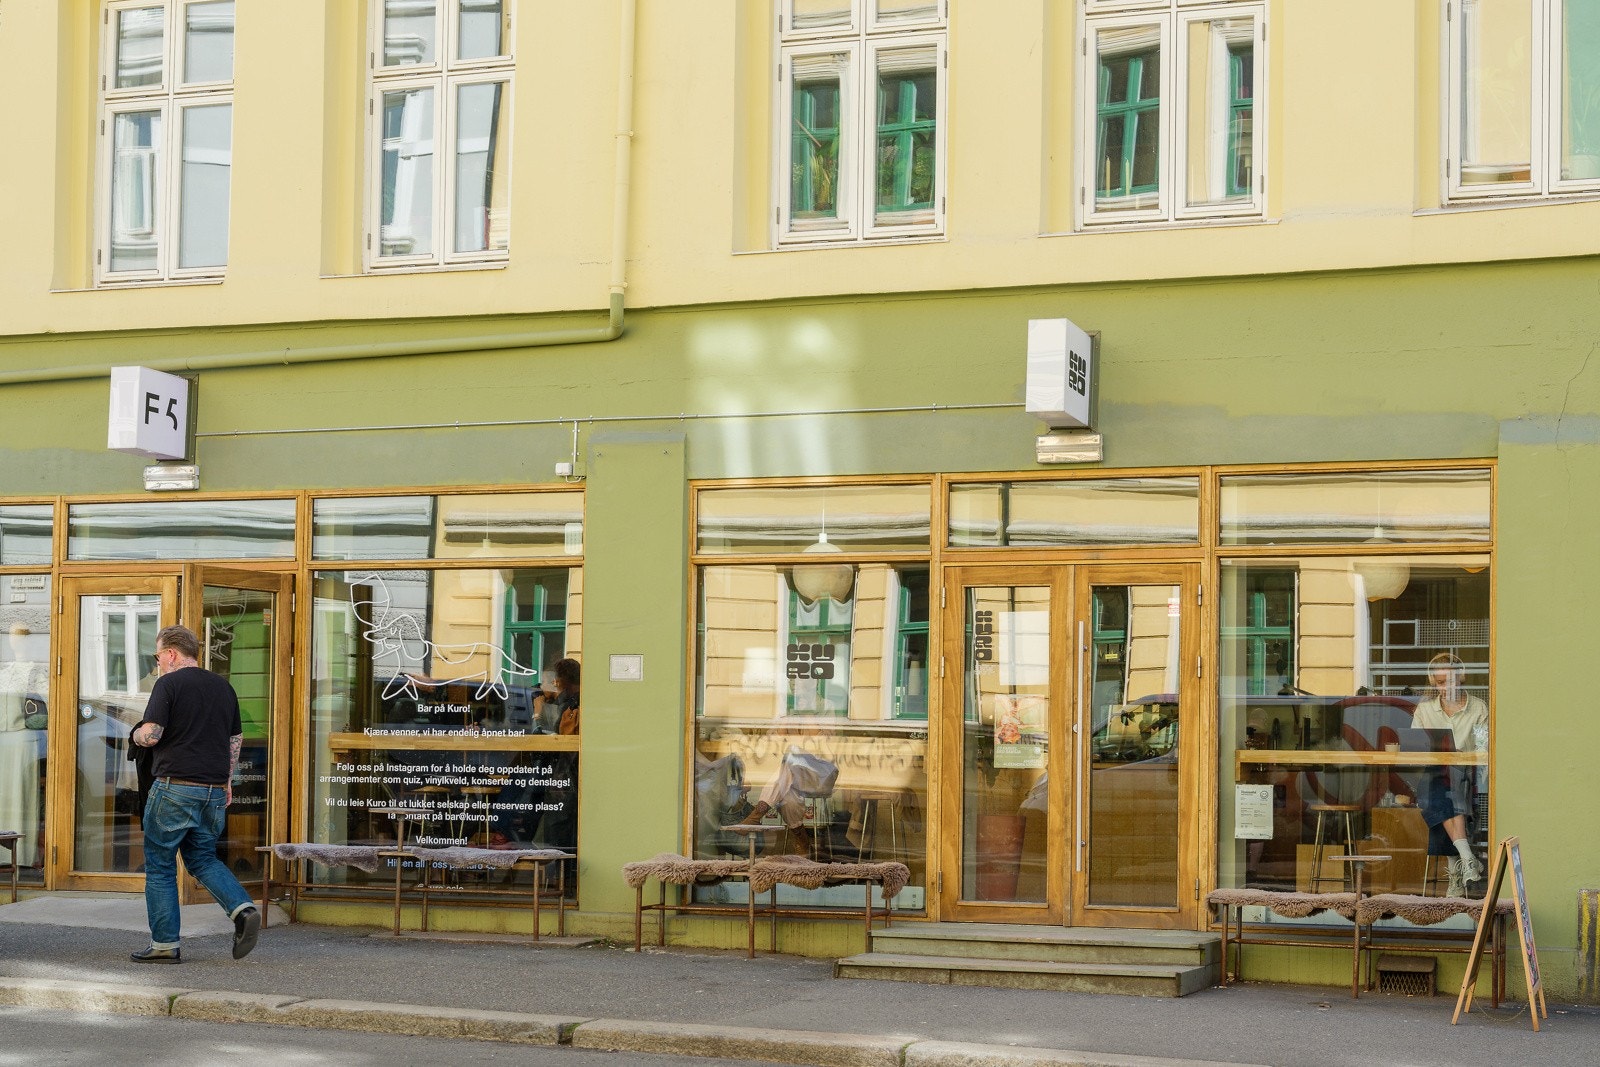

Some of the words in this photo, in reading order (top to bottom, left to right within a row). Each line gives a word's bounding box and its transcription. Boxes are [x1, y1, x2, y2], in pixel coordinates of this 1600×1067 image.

[417, 704, 432, 713] Bar
[434, 704, 445, 714] på
[447, 704, 471, 713] Kuro!
[363, 727, 389, 737] Kjære
[390, 729, 421, 737] venner,
[422, 728, 430, 736] vi
[432, 728, 447, 736] har
[448, 729, 479, 738] endelig
[481, 729, 506, 738] åpnet
[508, 729, 525, 737] bar!
[336, 762, 355, 772] Følg
[373, 763, 384, 773] på
[386, 763, 429, 773] Instagram
[430, 764, 443, 772] for
[444, 764, 451, 773] å
[452, 764, 476, 773] holde
[478, 765, 495, 774] deg
[496, 765, 539, 775] oppdatert
[541, 765, 553, 775] på
[319, 775, 380, 784] arrangementer
[403, 776, 423, 785] quiz,
[425, 776, 470, 786] vinylkveld,
[471, 776, 513, 786] konserter
[514, 778, 526, 787] og
[528, 777, 570, 788] denslags!
[324, 798, 335, 806] Vil
[337, 798, 348, 807] du
[349, 798, 365, 807] leie
[366, 799, 387, 807] Kuro
[388, 799, 397, 808] til
[398, 800, 407, 808] et
[409, 800, 435, 808] lukket
[436, 800, 470, 810] selskap
[471, 801, 491, 810] eller
[535, 802, 564, 812] plass?
[432, 812, 443, 821] på
[444, 813, 499, 822] bar@kuro.no
[416, 835, 468, 845] Velkommen!
[432, 861, 448, 869] oss
